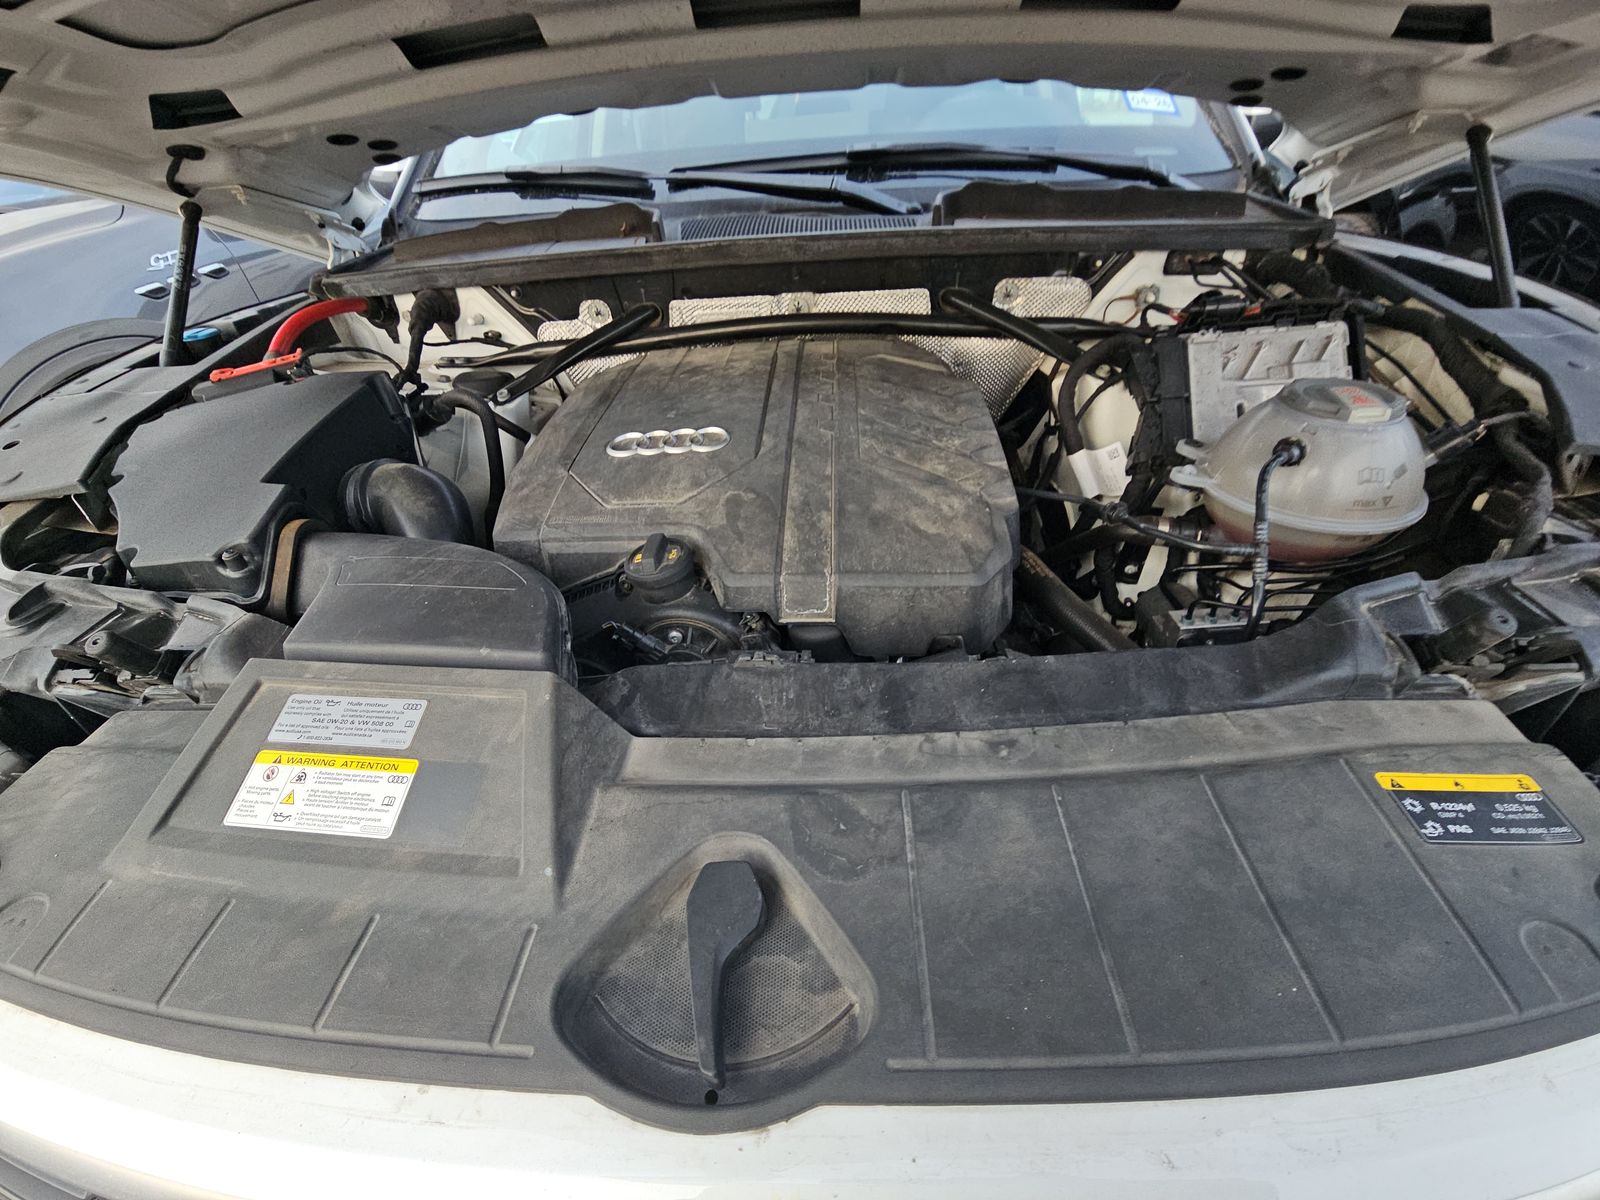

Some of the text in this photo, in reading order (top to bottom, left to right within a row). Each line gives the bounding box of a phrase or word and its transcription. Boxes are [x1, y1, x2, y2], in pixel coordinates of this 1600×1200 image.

[1352, 499, 1377, 508] max
[286, 757, 400, 770] WARNING ATTENTION
[1447, 824, 1474, 833] PAG
